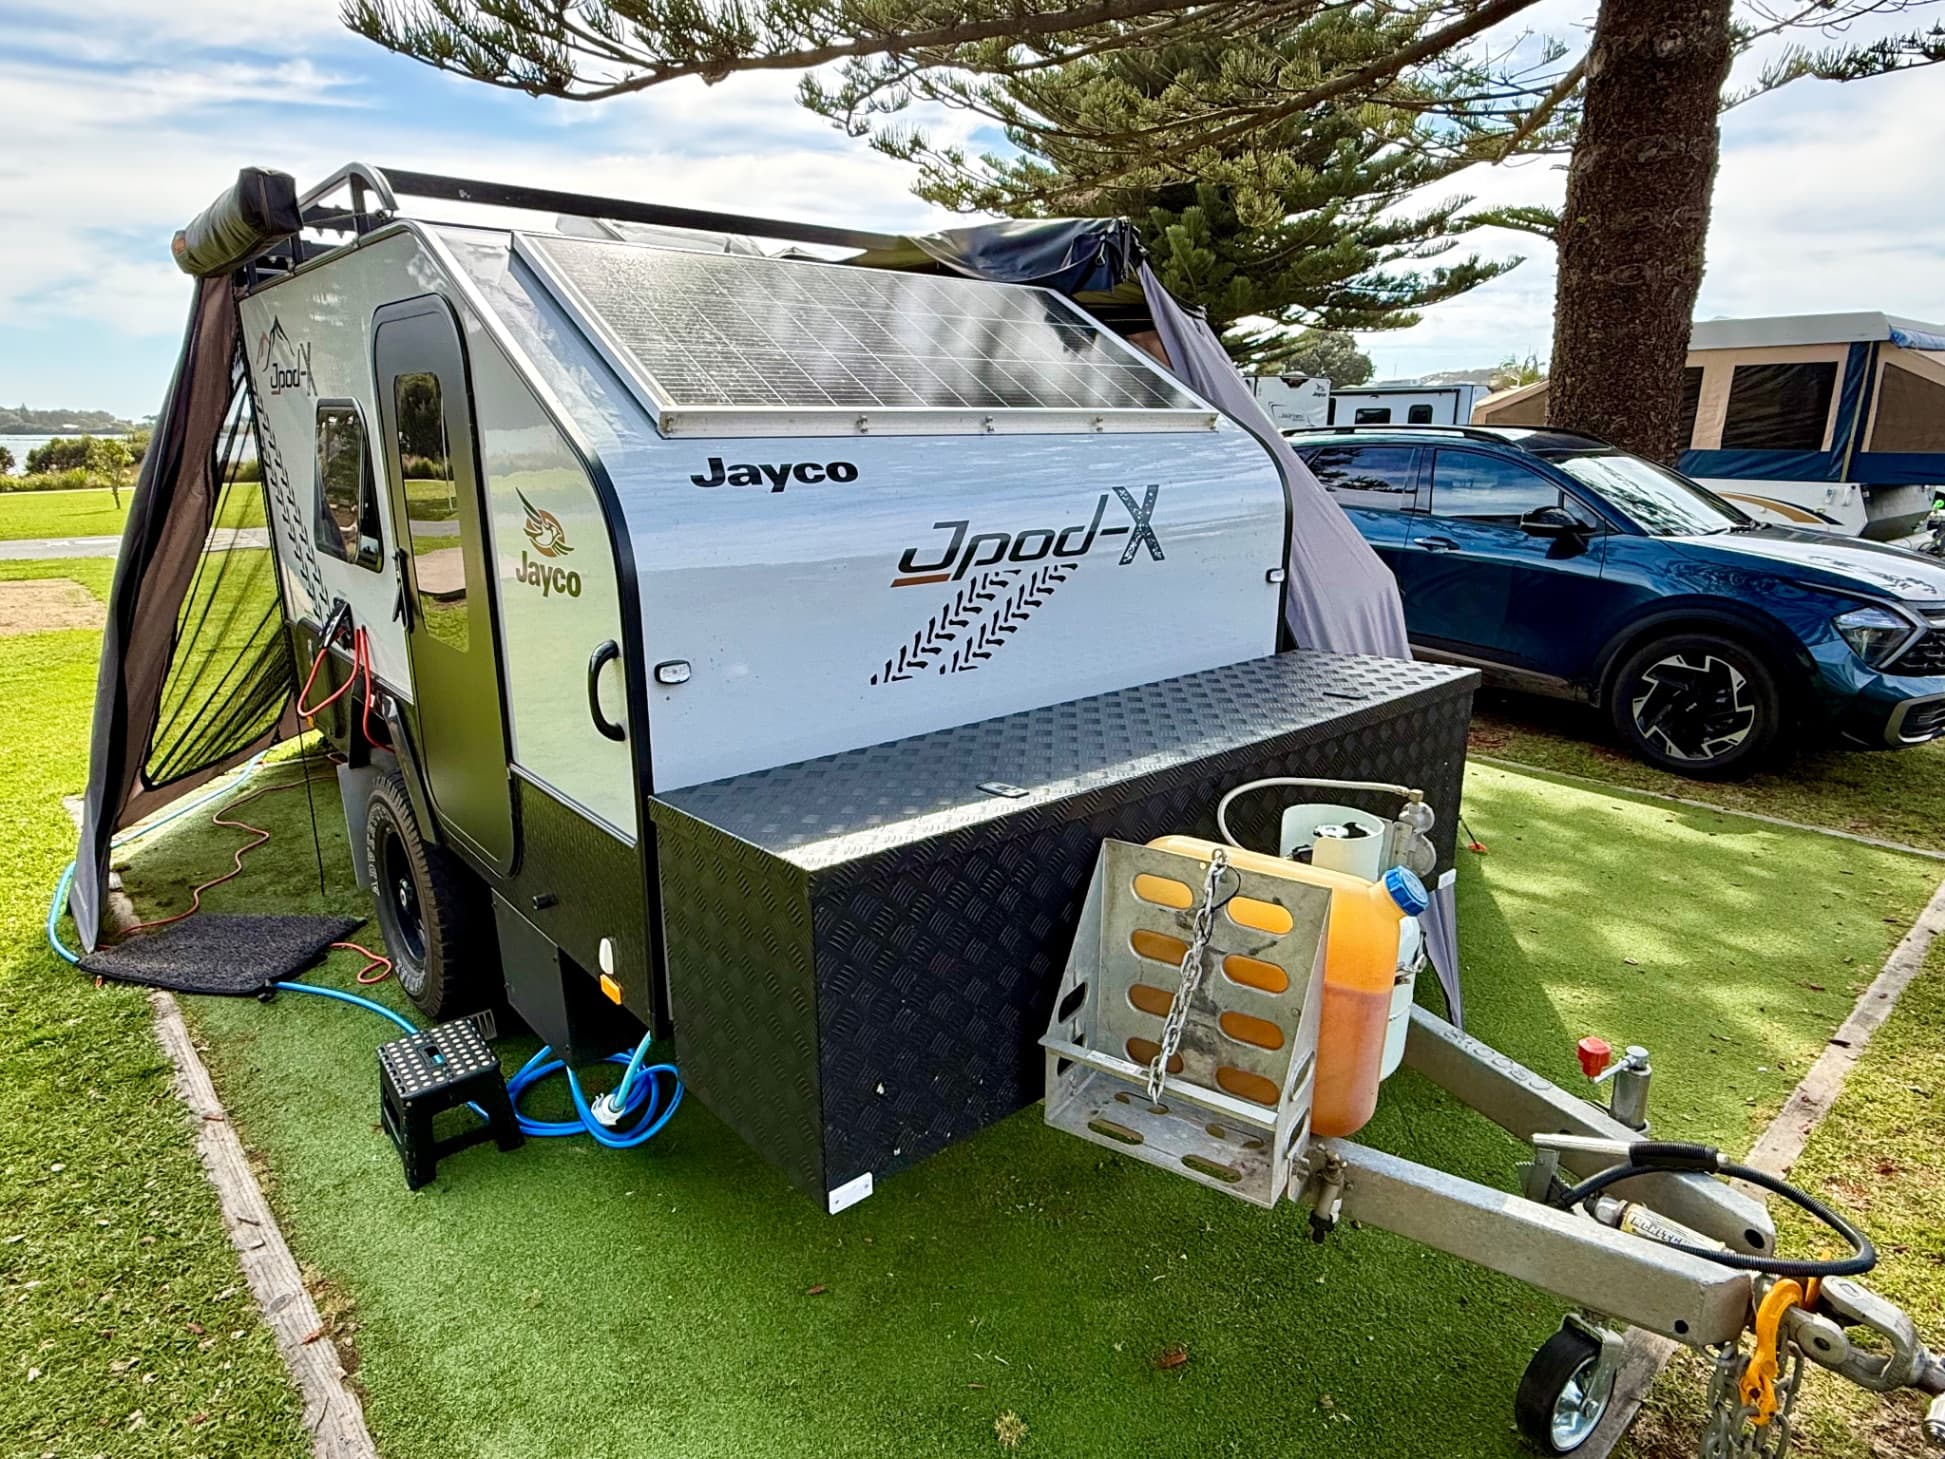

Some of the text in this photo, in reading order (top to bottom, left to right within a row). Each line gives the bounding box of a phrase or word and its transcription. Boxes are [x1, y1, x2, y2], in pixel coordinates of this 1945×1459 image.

[270, 341, 318, 395] Jpod-X
[690, 457, 859, 493] Jayco
[896, 484, 1165, 581] Jpod-X
[516, 550, 582, 598] Jayco
